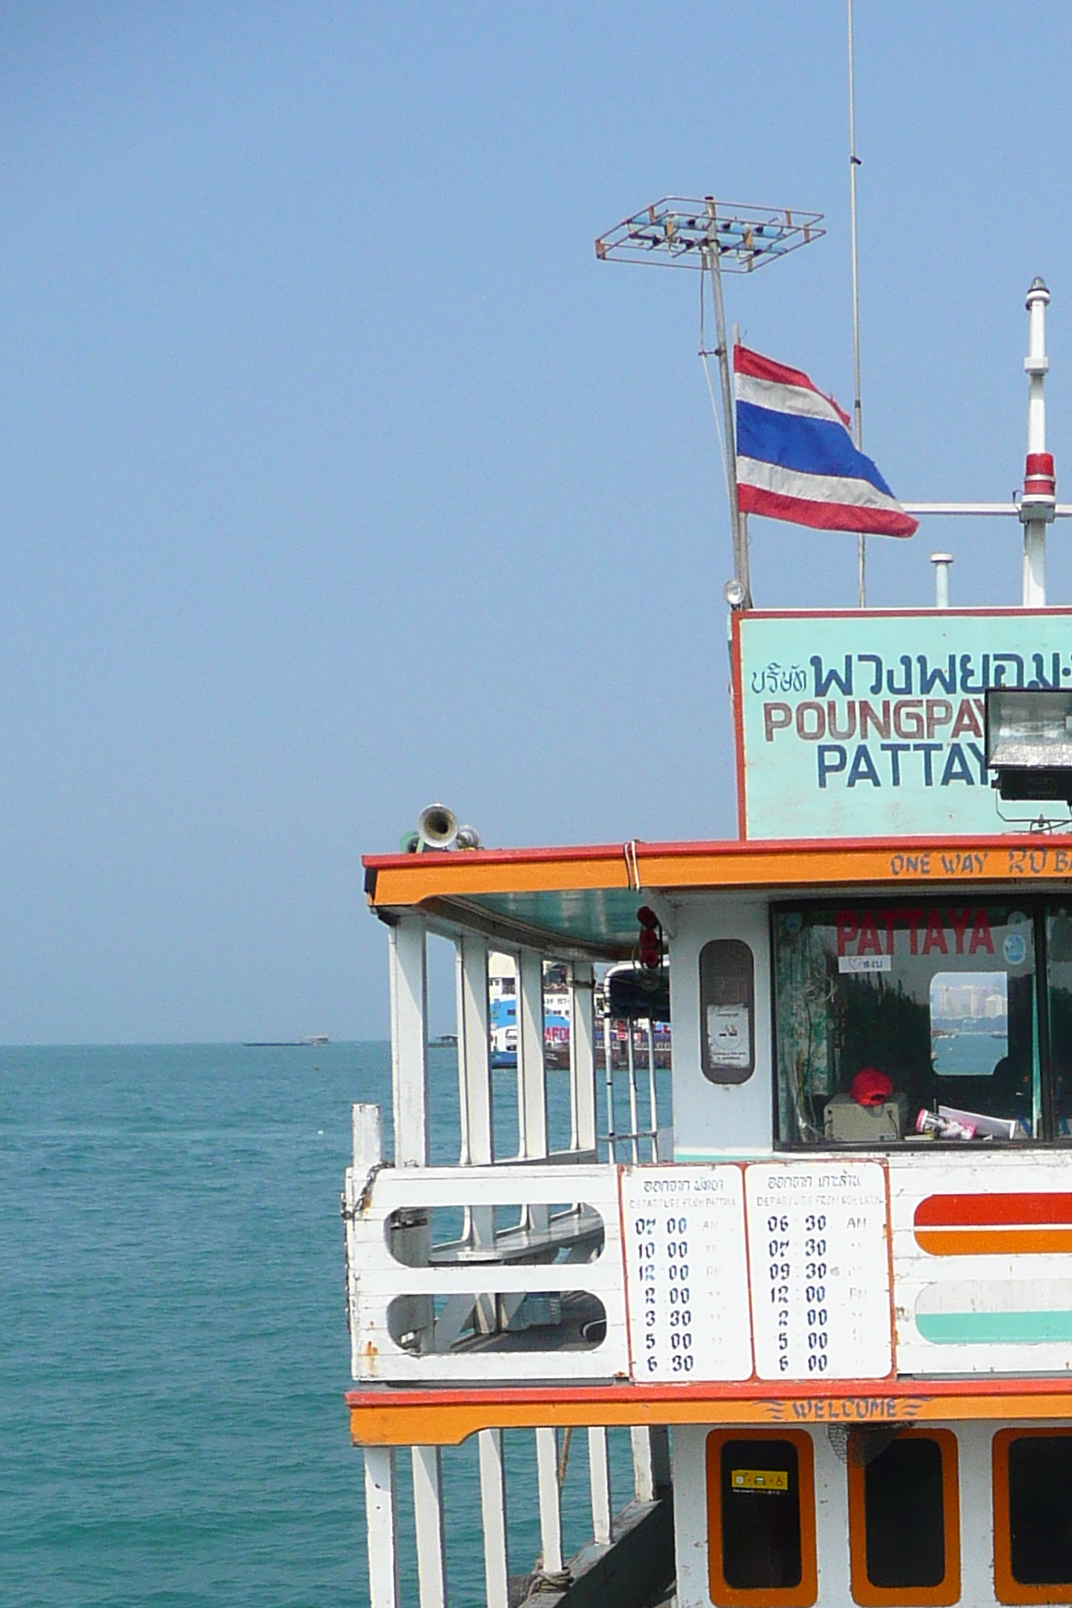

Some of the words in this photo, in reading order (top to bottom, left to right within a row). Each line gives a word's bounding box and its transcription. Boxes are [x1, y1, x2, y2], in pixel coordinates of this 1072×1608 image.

[763, 698, 986, 742] POUNGPA
[817, 742, 989, 788] PATTAY
[890, 853, 931, 876] ONE
[941, 852, 988, 875] WAY
[1008, 846, 1048, 874] 20
[836, 906, 996, 956] PATTAYA
[846, 1216, 867, 1229] AM
[791, 1396, 898, 1419] WELCOME
